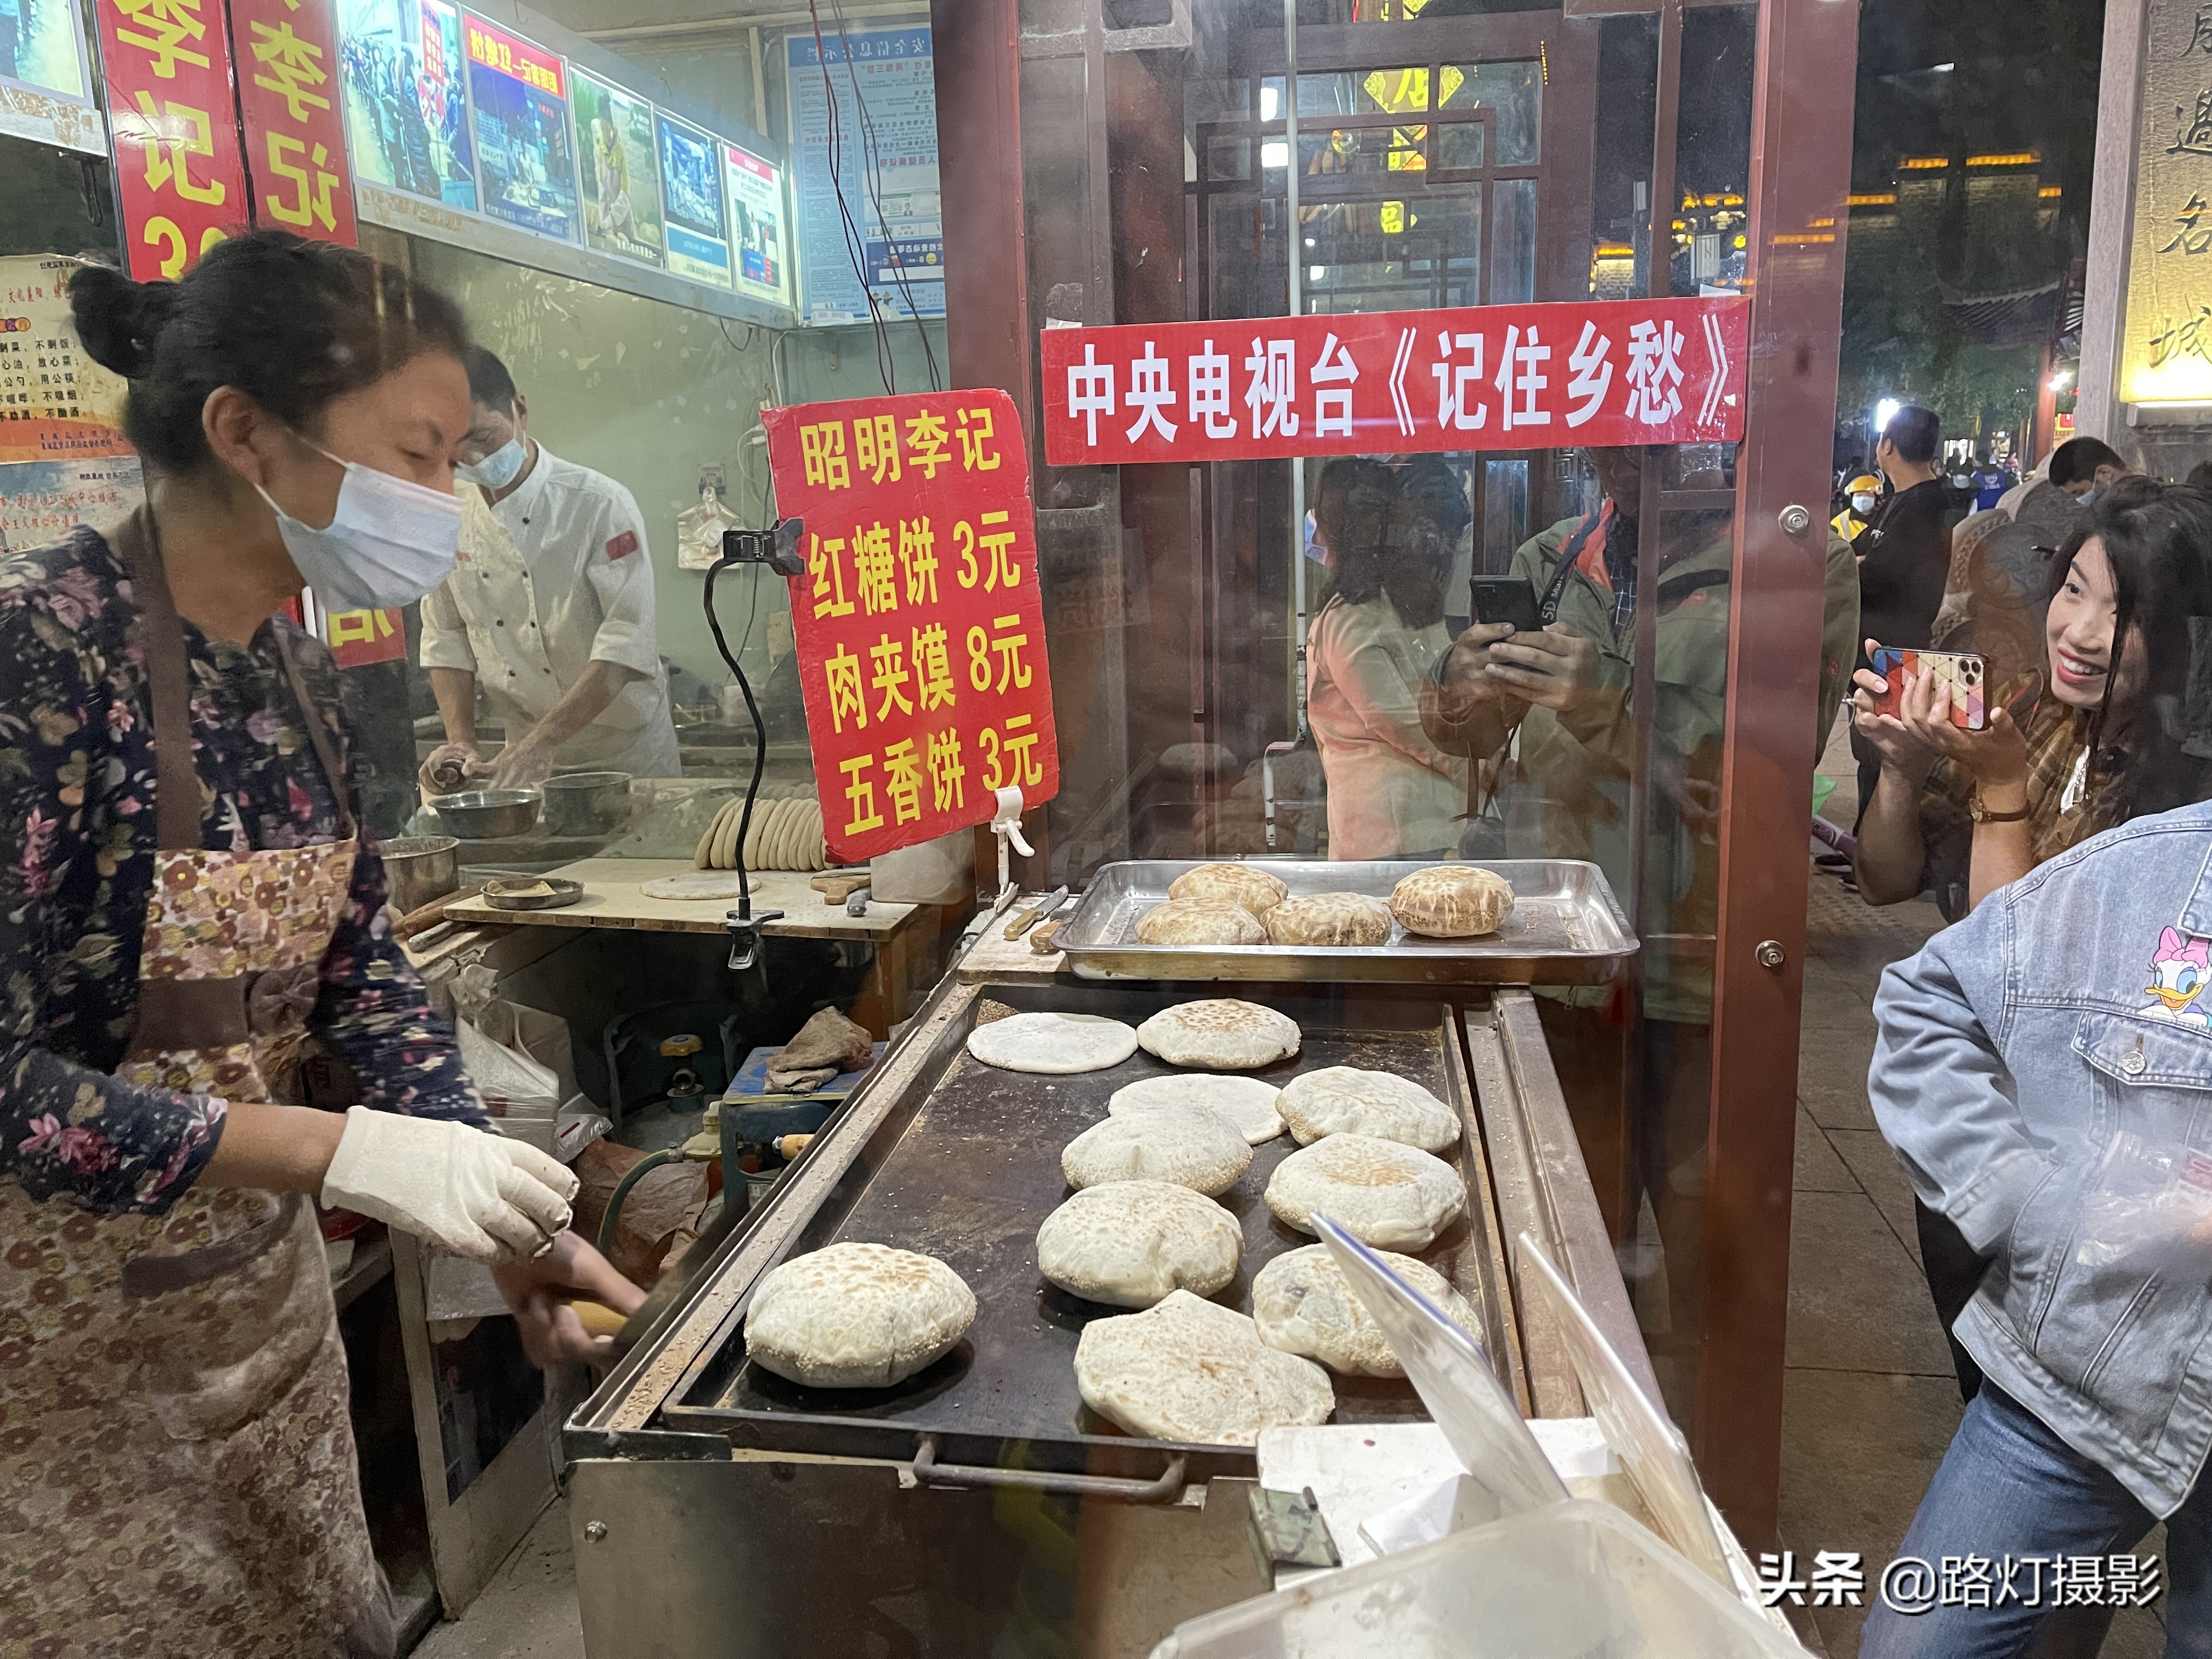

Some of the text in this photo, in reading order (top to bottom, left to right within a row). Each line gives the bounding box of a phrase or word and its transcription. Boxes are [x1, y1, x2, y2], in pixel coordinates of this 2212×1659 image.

[1067, 313, 1729, 447] 中央电视台《记住乡愁》
[800, 408, 1001, 490] 昭明李记
[808, 510, 1021, 619] 红糖饼 3元
[825, 613, 1032, 734] 肉夹馍 8元
[839, 714, 1043, 837] 五香饼 3元
